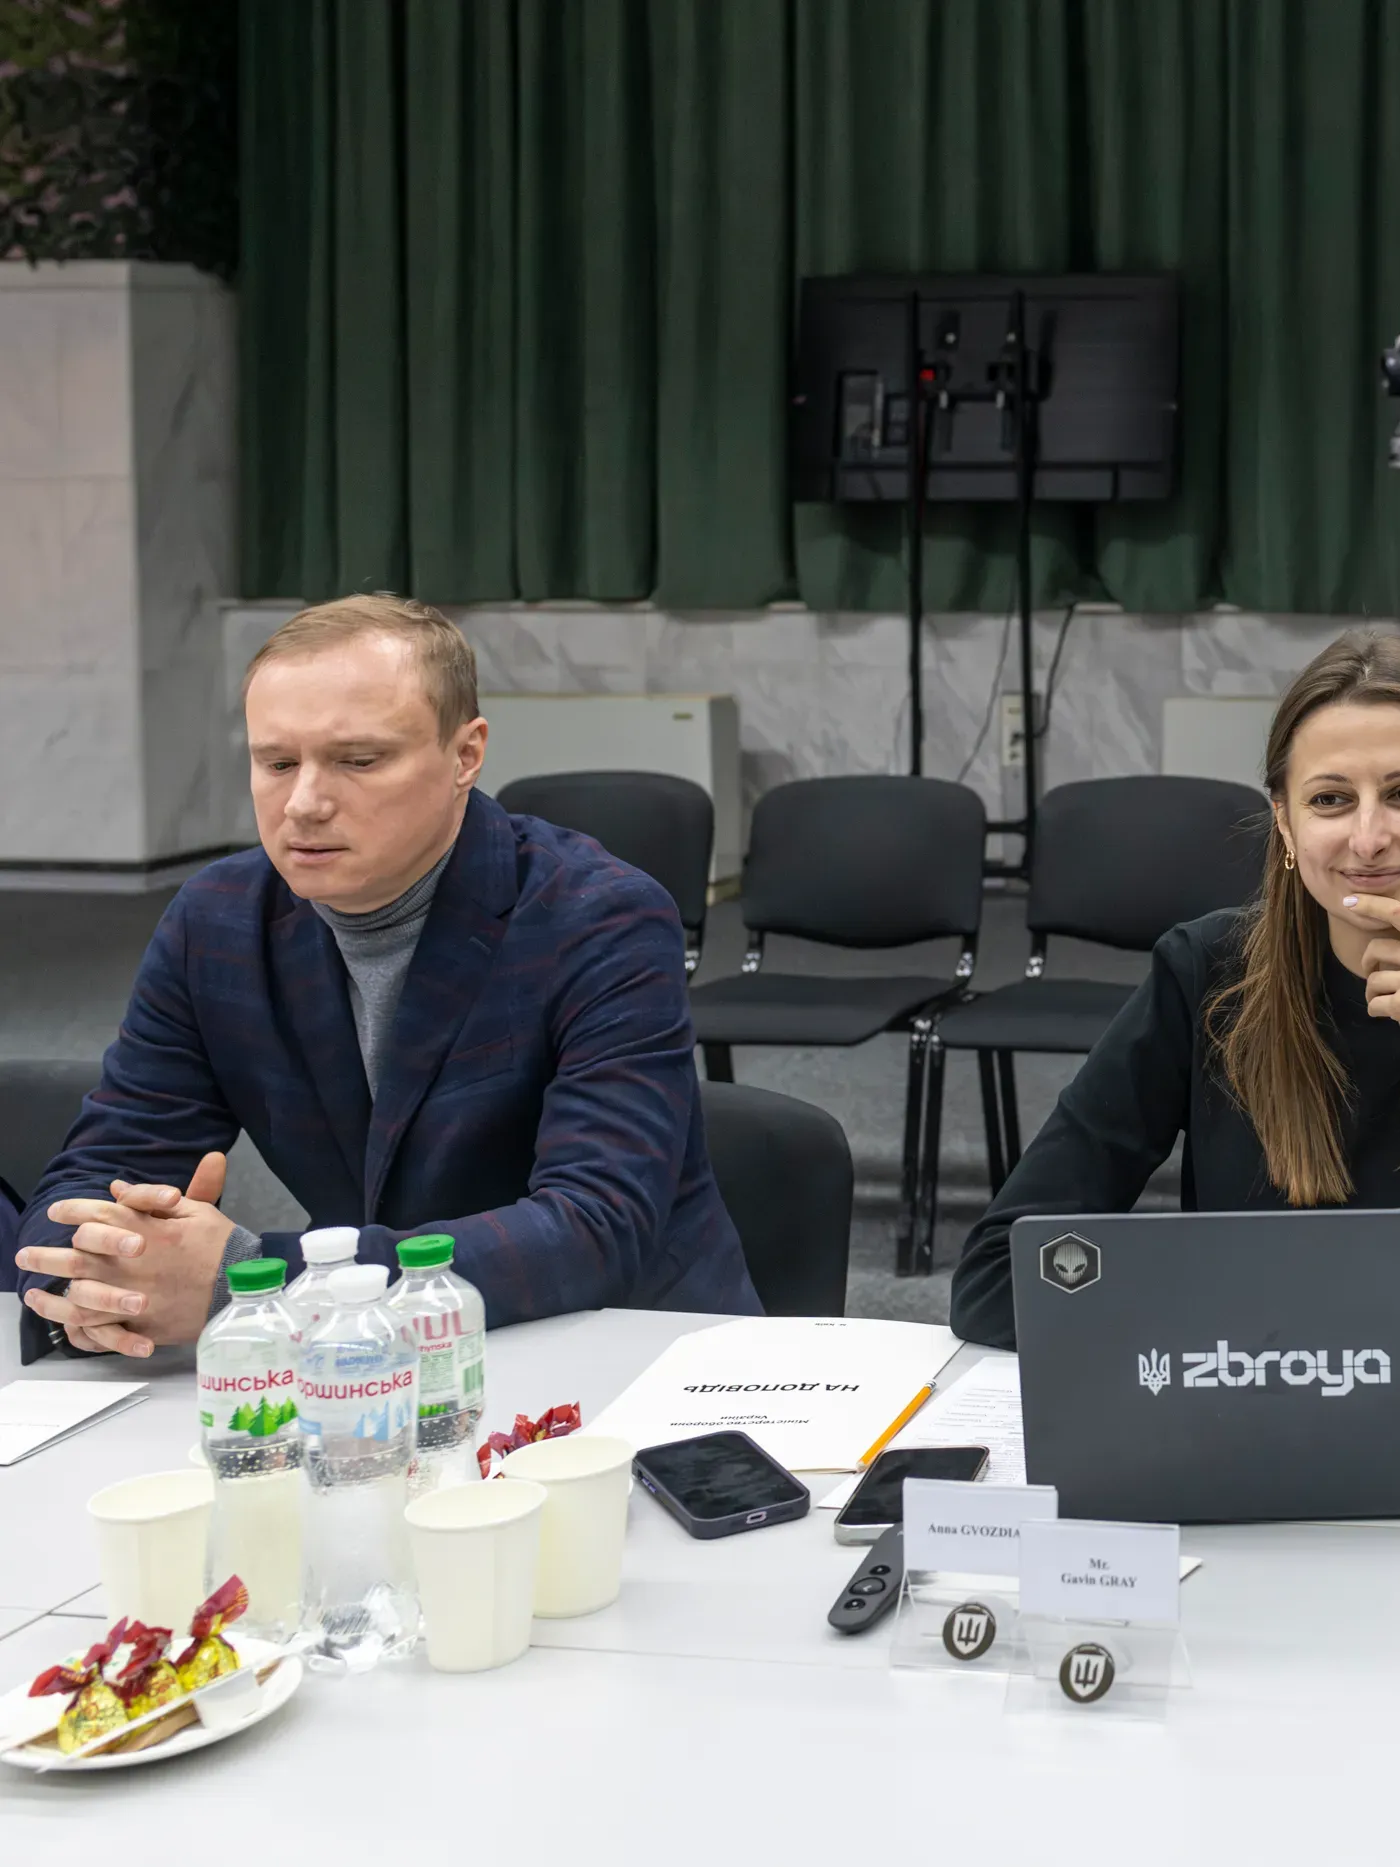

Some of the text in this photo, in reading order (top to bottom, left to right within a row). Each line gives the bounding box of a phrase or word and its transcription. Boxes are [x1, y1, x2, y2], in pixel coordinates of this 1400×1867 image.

[1182, 1339, 1392, 1397] zbroya
[683, 1382, 860, 1394] НА ДОПОВІДЬ
[928, 1522, 958, 1536] Anna
[1089, 1558, 1110, 1571] Mr.
[1061, 1573, 1138, 1589] Gavin GRAY
